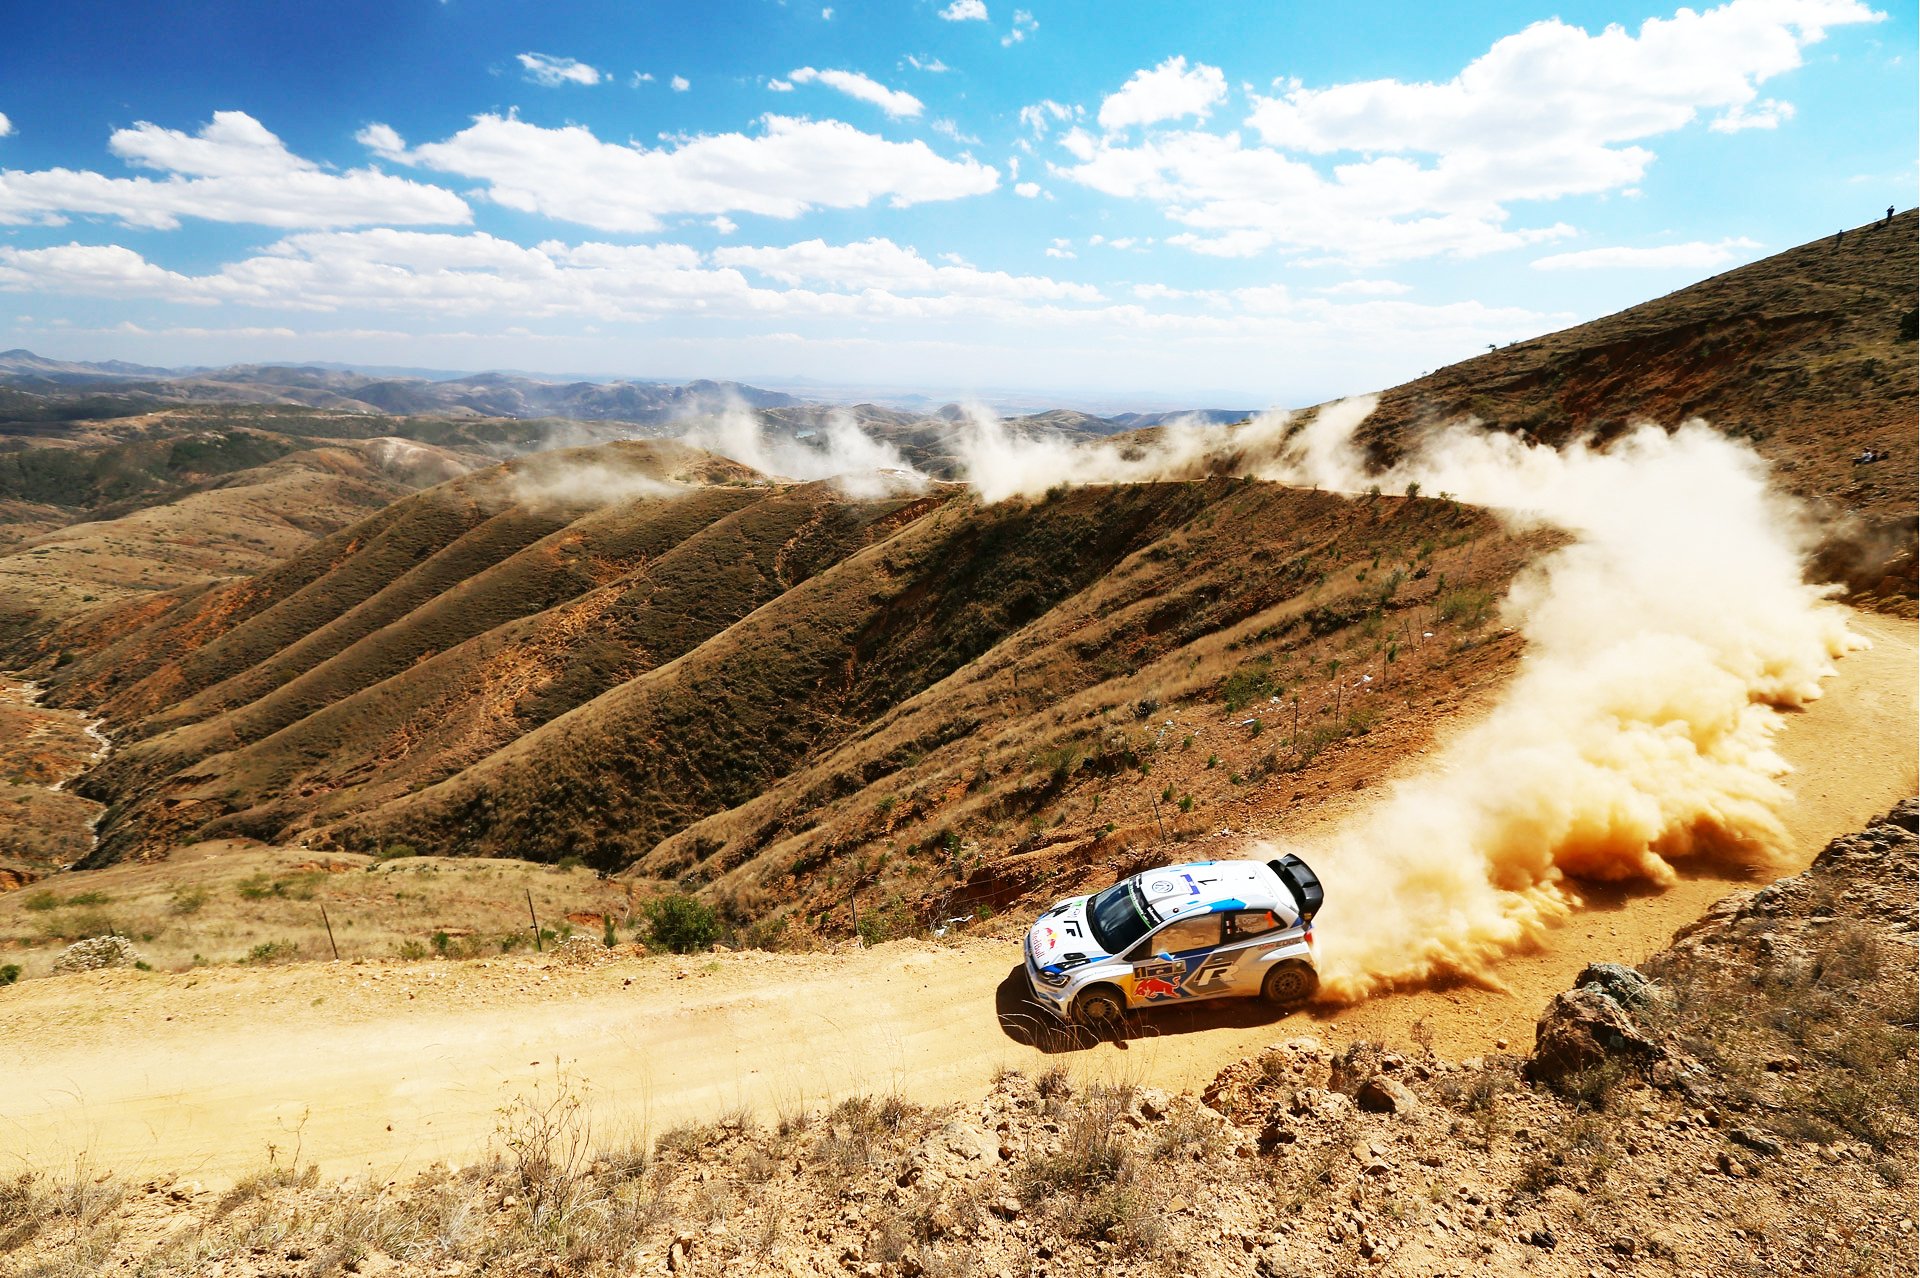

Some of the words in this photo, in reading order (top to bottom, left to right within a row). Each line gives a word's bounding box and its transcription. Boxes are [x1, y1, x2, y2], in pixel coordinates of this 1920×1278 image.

[1197, 878, 1218, 886] 1
[1263, 910, 1275, 929] 1
[1193, 961, 1240, 987] R
